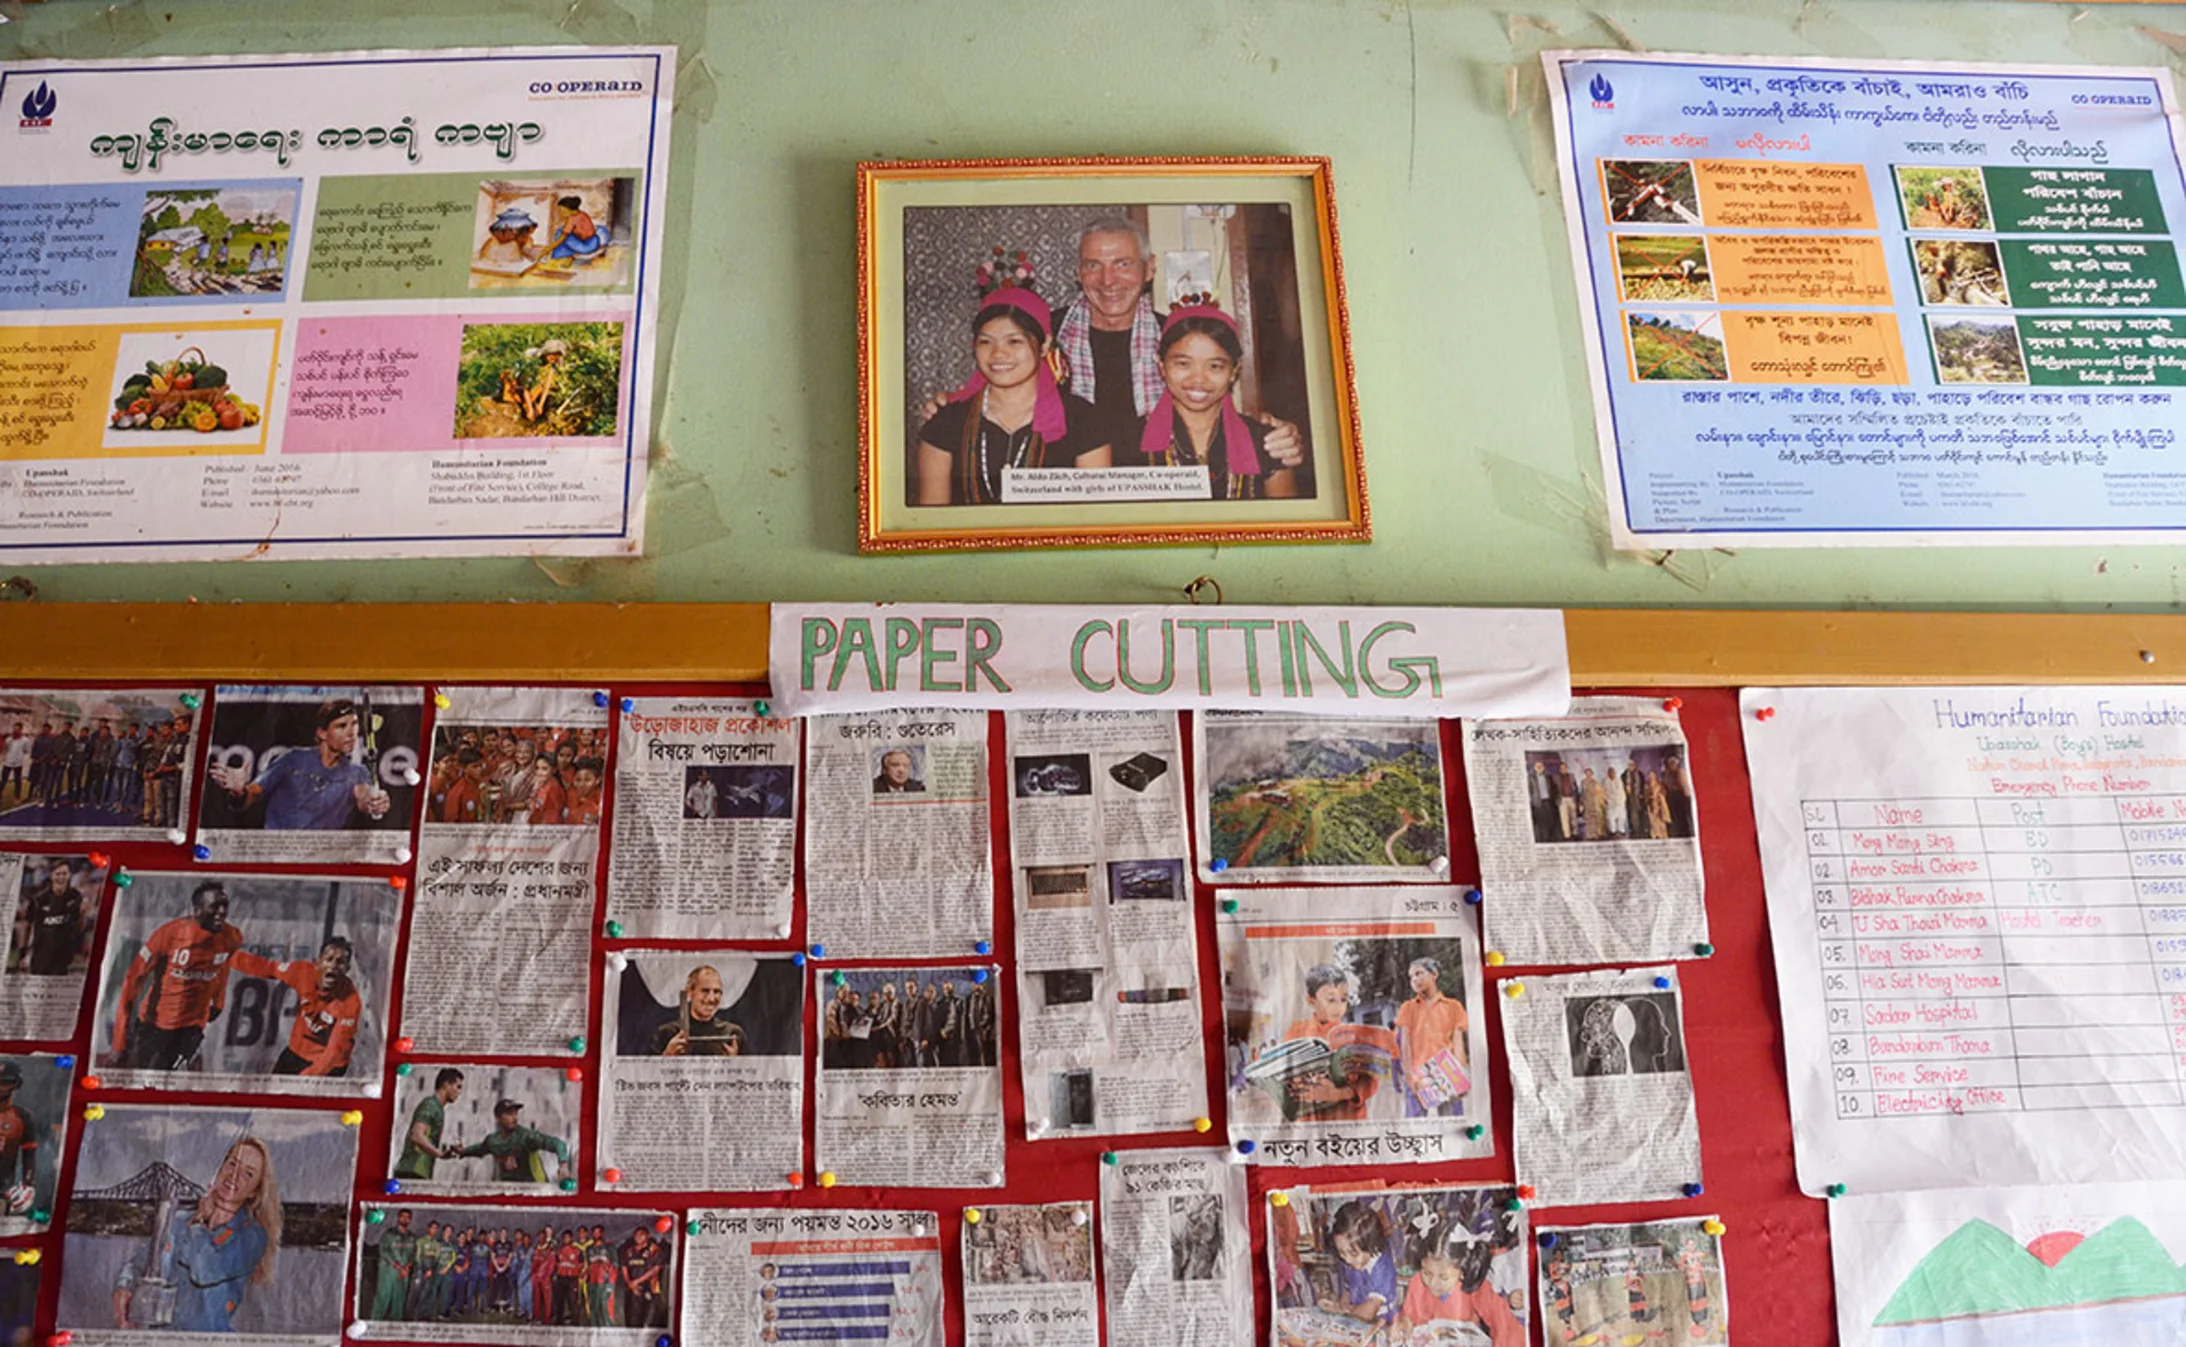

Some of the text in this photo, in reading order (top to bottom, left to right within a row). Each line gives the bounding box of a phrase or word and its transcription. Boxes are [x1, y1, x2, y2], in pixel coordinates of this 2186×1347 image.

[1766, 75, 1846, 98] প্রকৃতিকে
[1917, 83, 1987, 98] আমরাও
[800, 617, 1442, 699] PAPER CUTTING
[1933, 697, 2079, 728] Humanitarian
[838, 719, 882, 739] জরুরি
[648, 738, 776, 764] বিষয়ে পড়াশোনা
[1874, 804, 1923, 825] Name
[559, 861, 588, 876] জন্য
[172, 949, 190, 964] 10
[1916, 1001, 1977, 1027] Hospital
[1263, 1139, 1308, 1163] নতুন
[1316, 1134, 1379, 1157] বইয়ের
[753, 1217, 785, 1234] জন্য
[848, 1215, 893, 1232] ২০১৬
